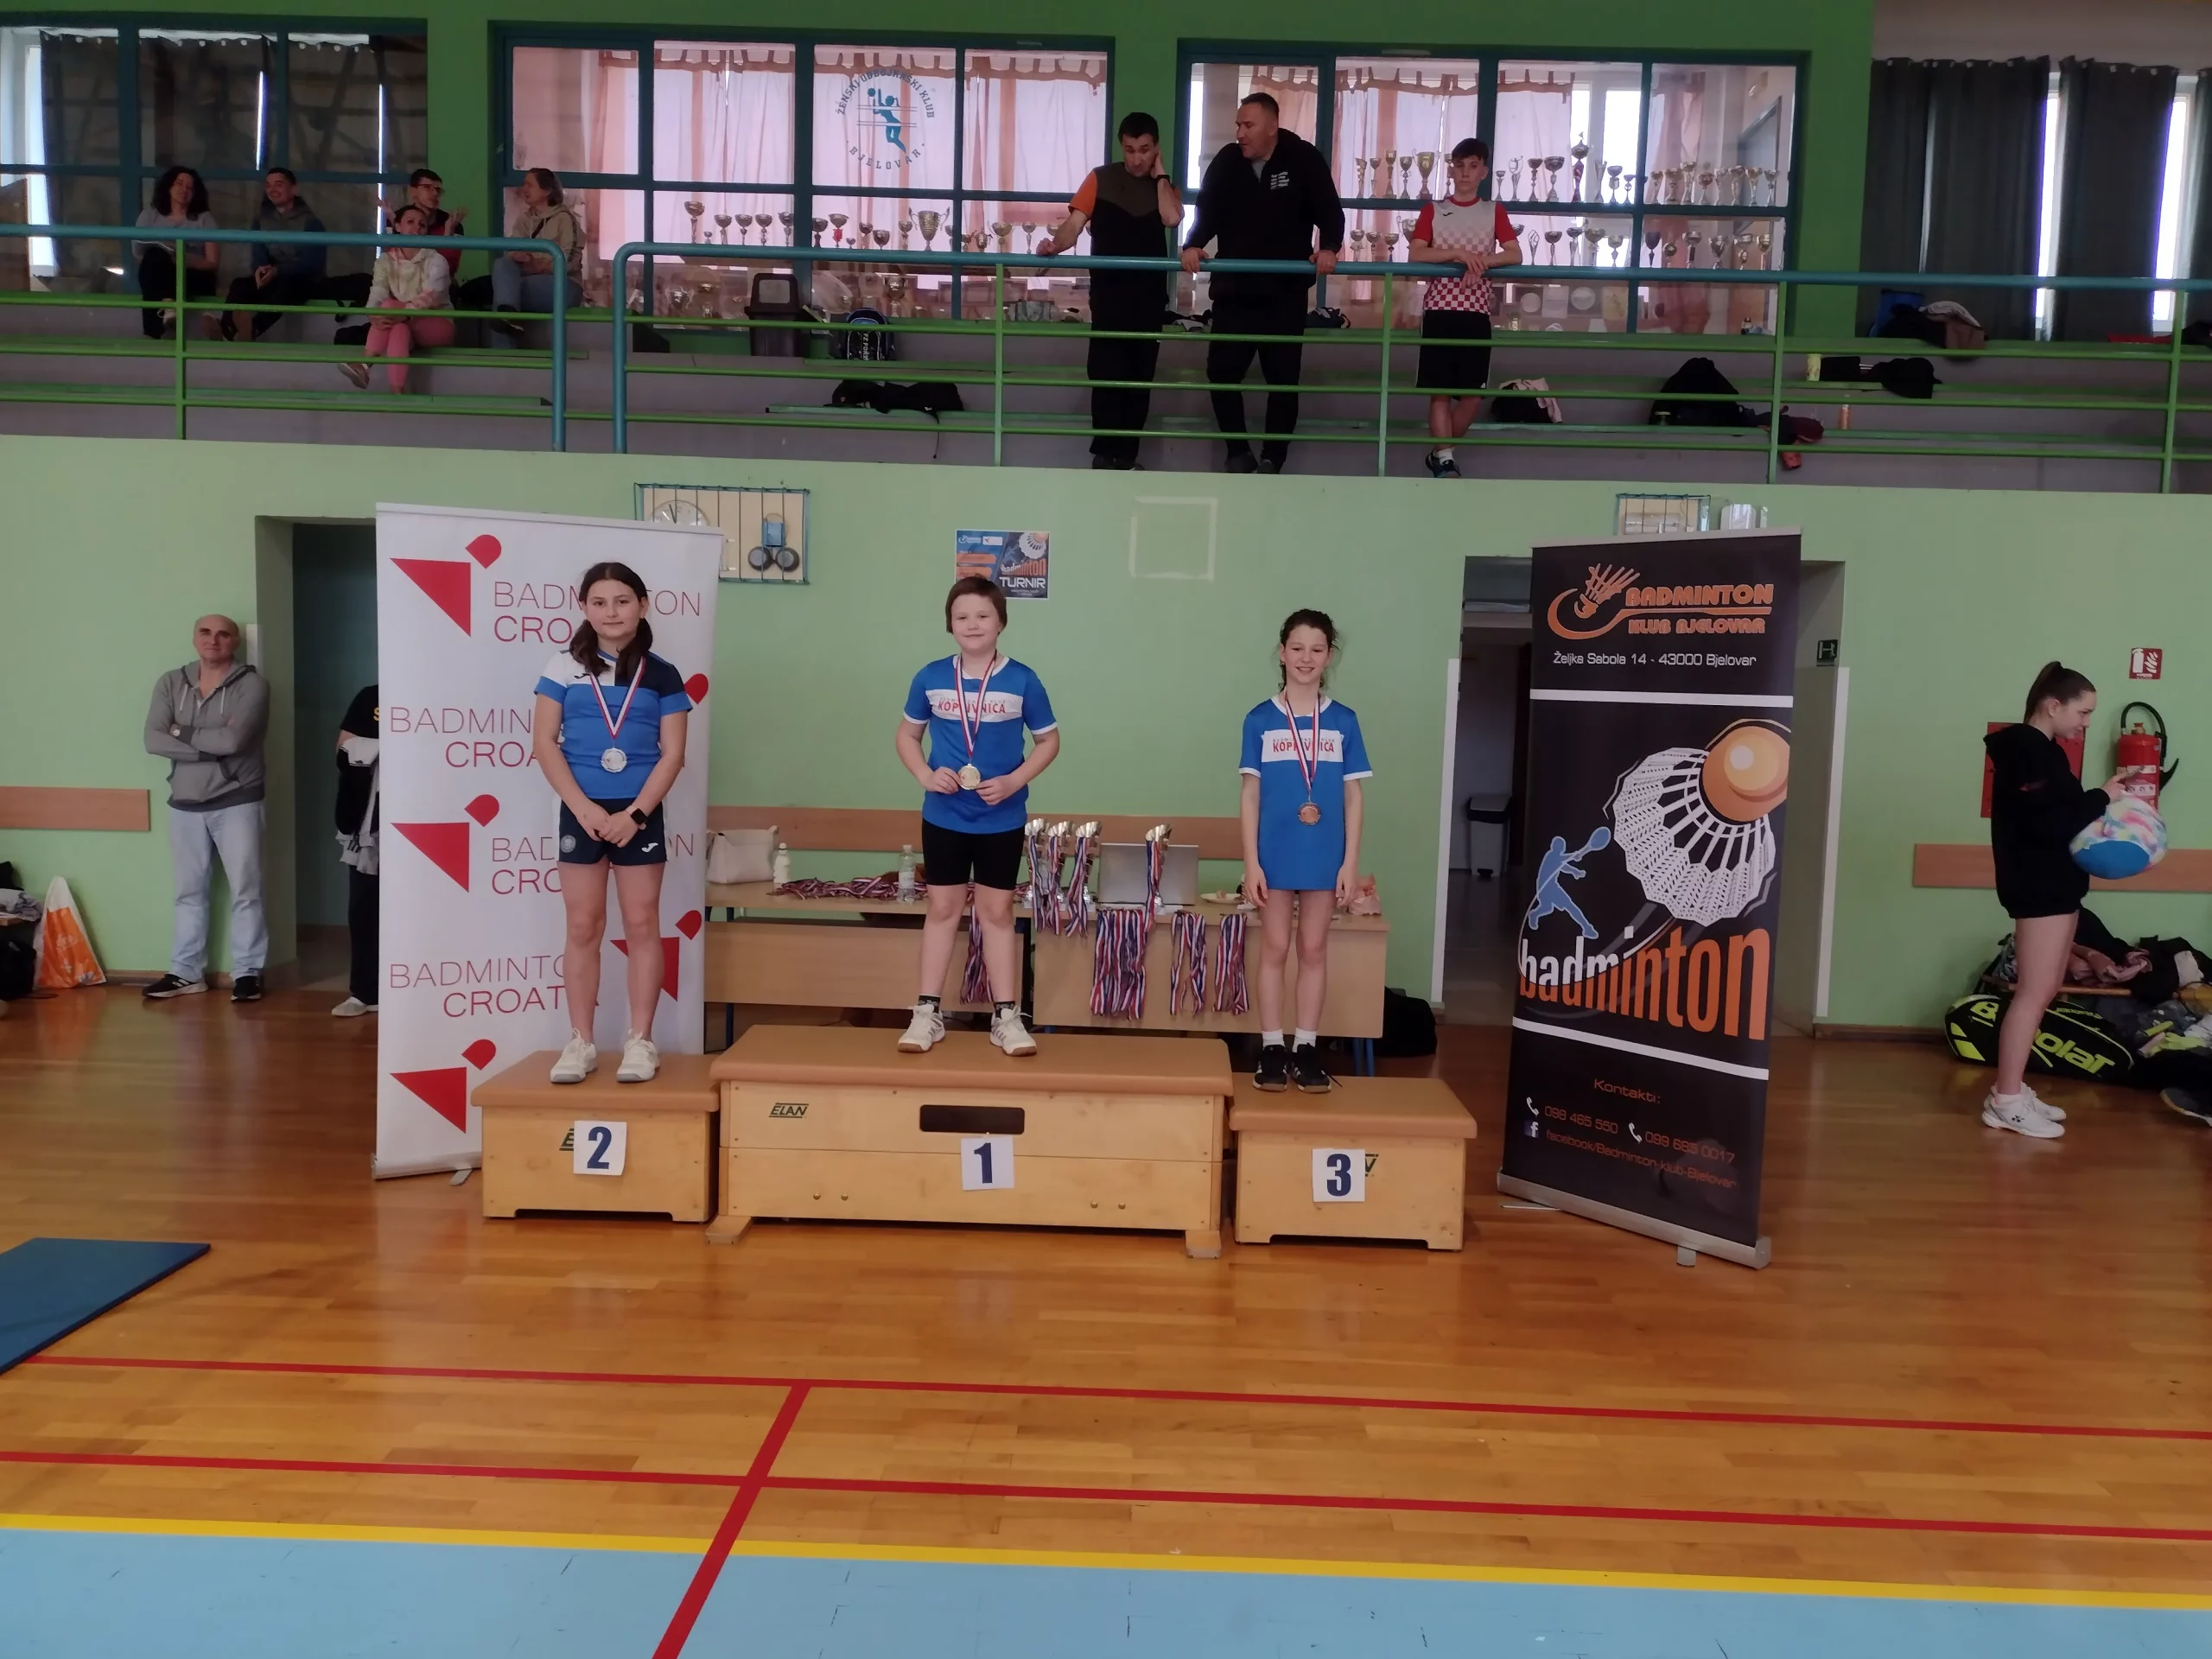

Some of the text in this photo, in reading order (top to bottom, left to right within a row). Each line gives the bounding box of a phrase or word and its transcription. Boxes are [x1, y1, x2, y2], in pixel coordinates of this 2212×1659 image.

[919, 90, 935, 118] KLUB
[849, 146, 921, 170] BJELOVAR
[999, 576, 1046, 588] TURNIR
[1625, 583, 1775, 607] BADMINTON
[1628, 617, 1766, 635] KLUB BJELOVAR
[1554, 650, 1584, 667] Željka
[1586, 652, 1626, 665] Sabola
[1630, 653, 1647, 665] 14
[1658, 653, 1703, 666] 43000
[1706, 653, 1758, 669] Bjelovar
[390, 707, 531, 734] BADMIN
[1519, 925, 1771, 1040] badminton
[770, 1105, 808, 1116] ELAN
[1544, 1105, 1567, 1121] 098
[1594, 1118, 1618, 1135] 550
[587, 1125, 613, 1170] 2
[1644, 1131, 1669, 1147] 099
[1700, 1145, 1735, 1163] 0017
[973, 1141, 994, 1185] 1
[1326, 1153, 1352, 1197] 3
